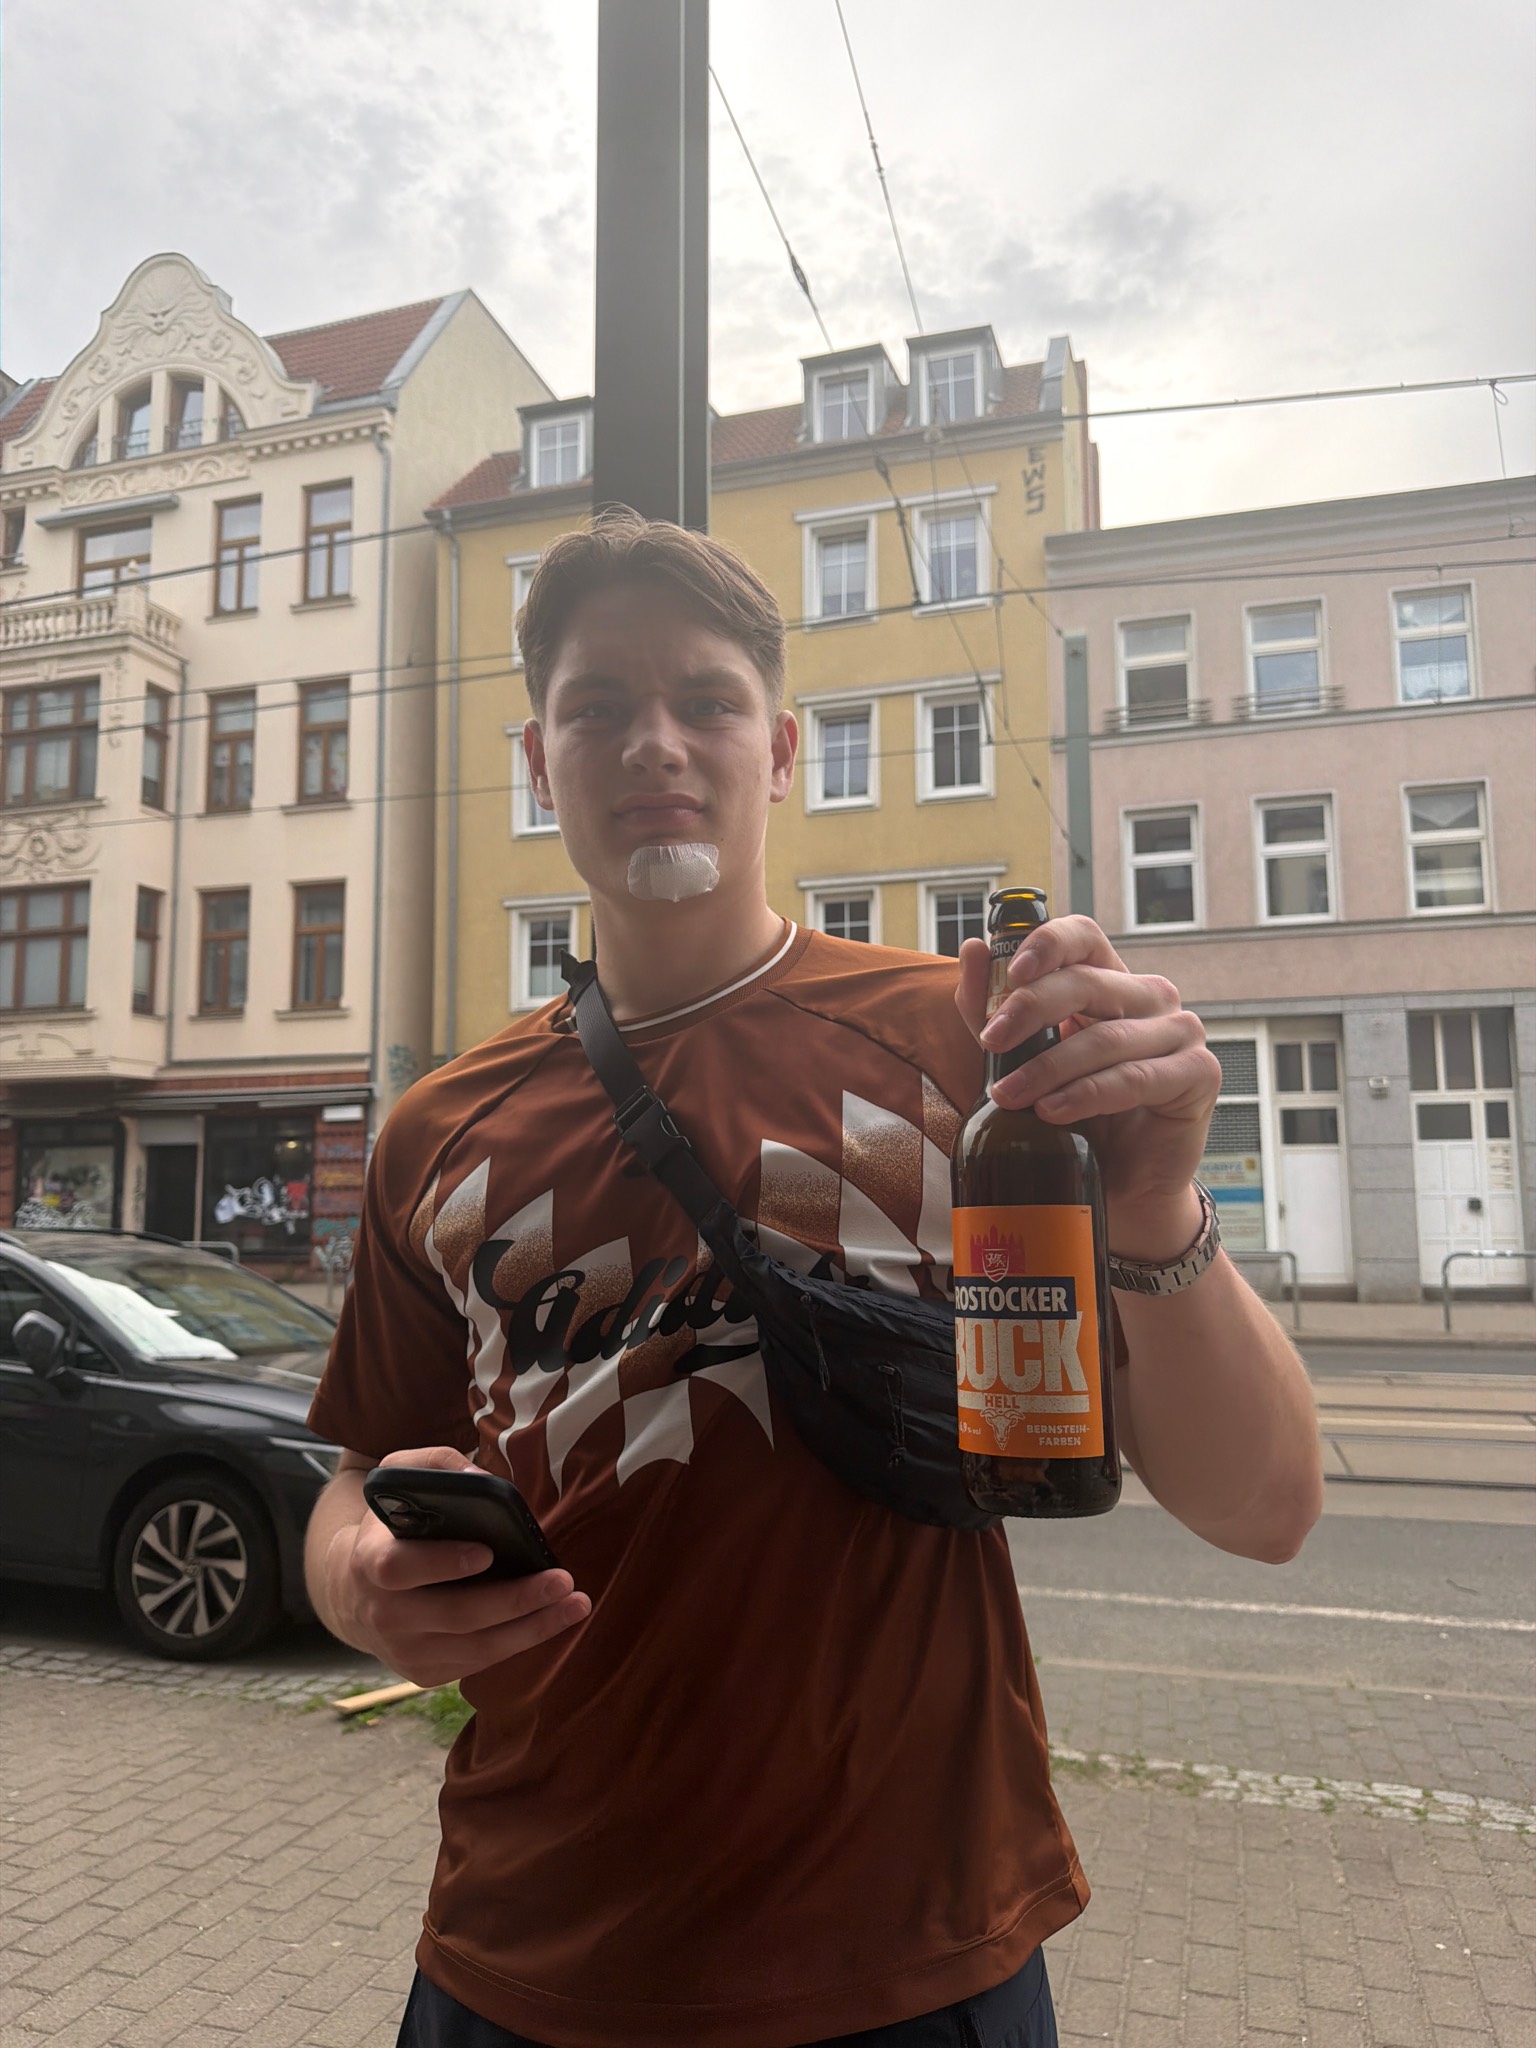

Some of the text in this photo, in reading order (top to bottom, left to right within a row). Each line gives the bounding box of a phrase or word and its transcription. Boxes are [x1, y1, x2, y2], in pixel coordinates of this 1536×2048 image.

[984, 1394, 1021, 1409] HELL
[1026, 1424, 1091, 1434] BERNSTEIN-
[1038, 1436, 1082, 1446] FARBEN
